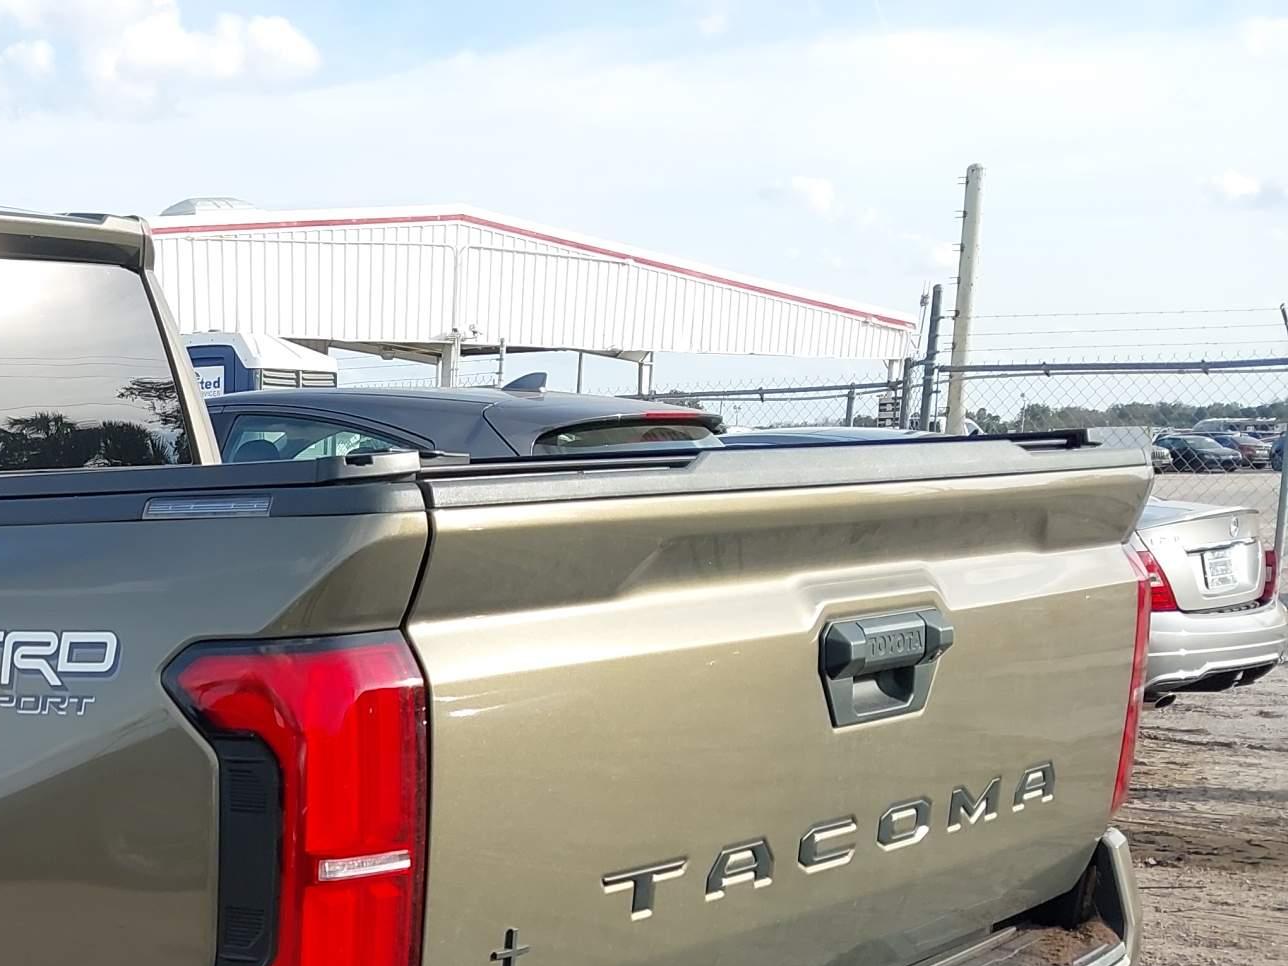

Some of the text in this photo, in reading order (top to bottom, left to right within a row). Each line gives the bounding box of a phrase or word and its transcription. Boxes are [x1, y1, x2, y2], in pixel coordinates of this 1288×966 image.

[199, 376, 221, 390] ted
[869, 630, 923, 657] TOYOTA
[601, 760, 1057, 922] TACOMA
